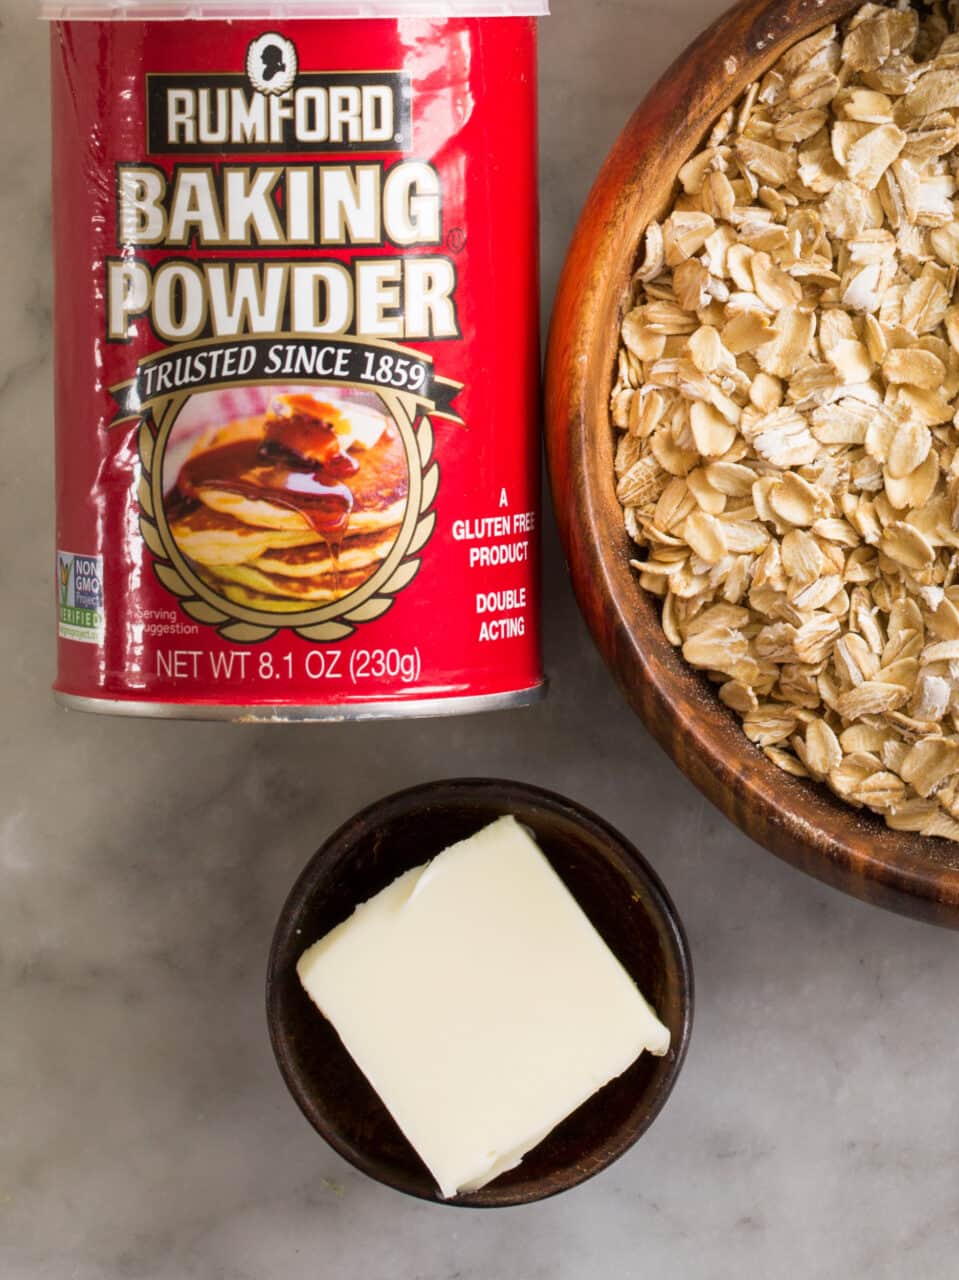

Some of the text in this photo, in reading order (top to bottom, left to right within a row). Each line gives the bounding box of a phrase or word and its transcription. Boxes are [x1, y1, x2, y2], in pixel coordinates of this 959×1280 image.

[166, 85, 396, 144] RUMFORD
[117, 161, 442, 246] BAKING
[107, 258, 459, 342] POWDER
[143, 344, 426, 395] TRUSTED SINCE 1859
[499, 488, 508, 508] A
[452, 512, 535, 541] GLUTEN FREE
[469, 541, 528, 568] PRODUCT
[76, 577, 101, 593] GMO
[476, 588, 526, 613] DOUBLE
[138, 622, 200, 637] uggestion
[478, 617, 525, 642] ACTING
[156, 647, 421, 684] NET WT 8.1 OZ (230g)
